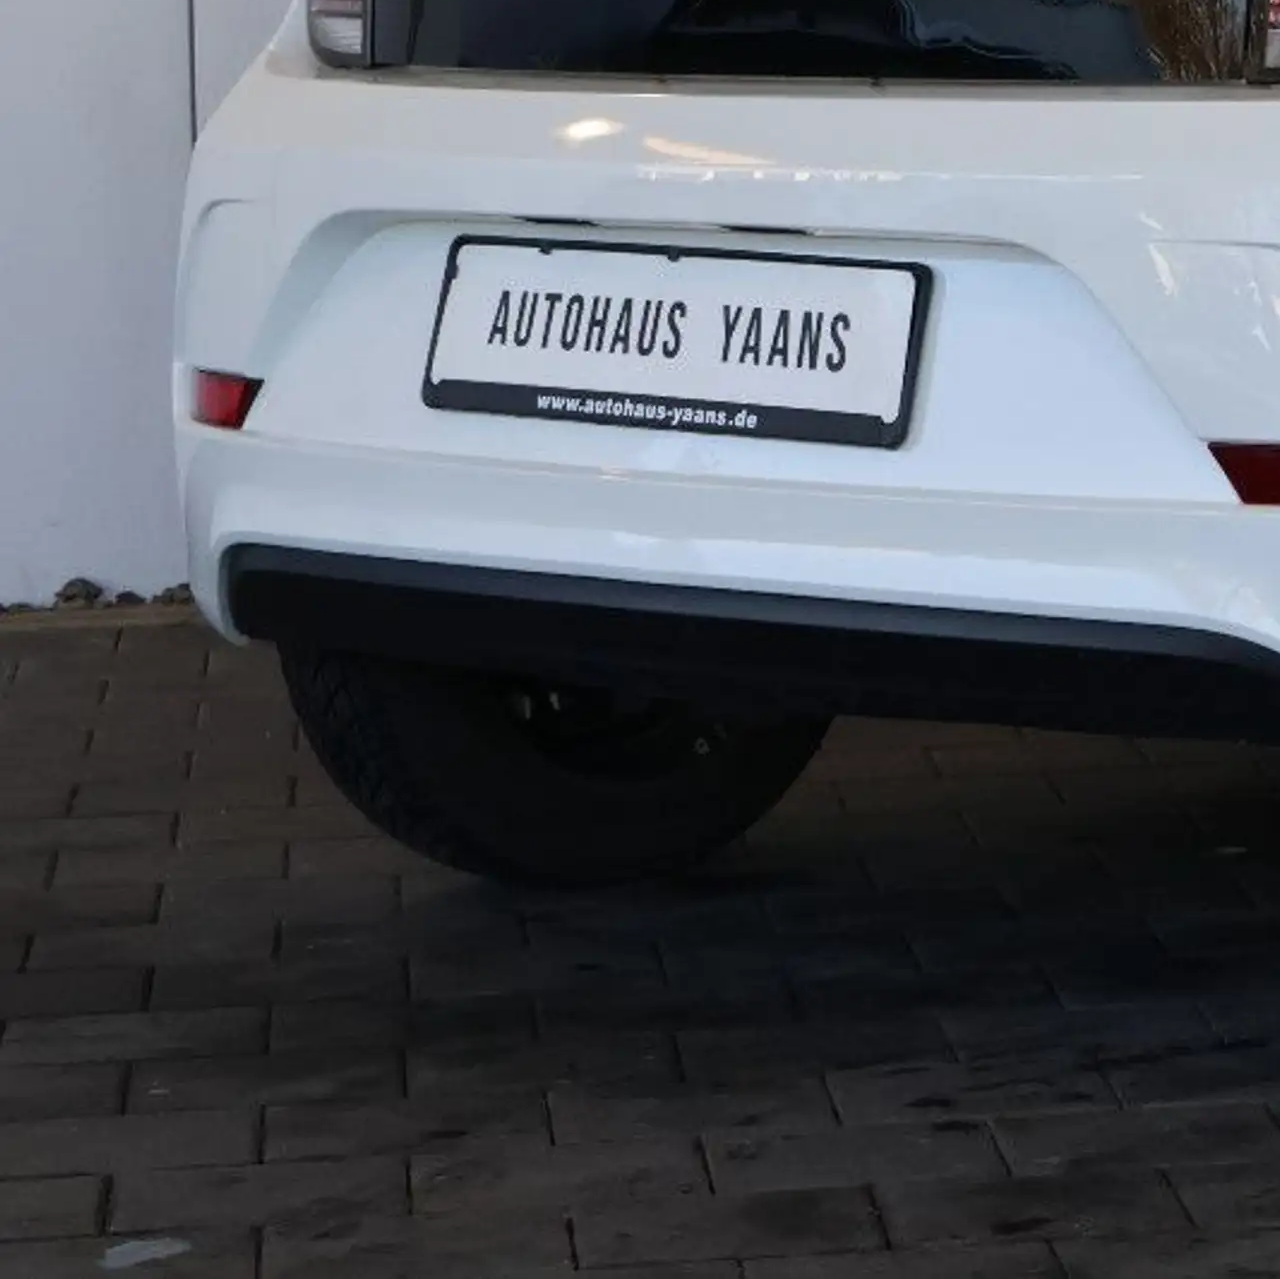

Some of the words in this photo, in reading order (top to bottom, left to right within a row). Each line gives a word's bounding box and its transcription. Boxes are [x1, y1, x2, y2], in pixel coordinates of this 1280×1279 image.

[487, 289, 688, 360] AUTOHAUS
[719, 303, 852, 374] YAANS
[536, 392, 759, 429] www.autohaus-yaans.de
